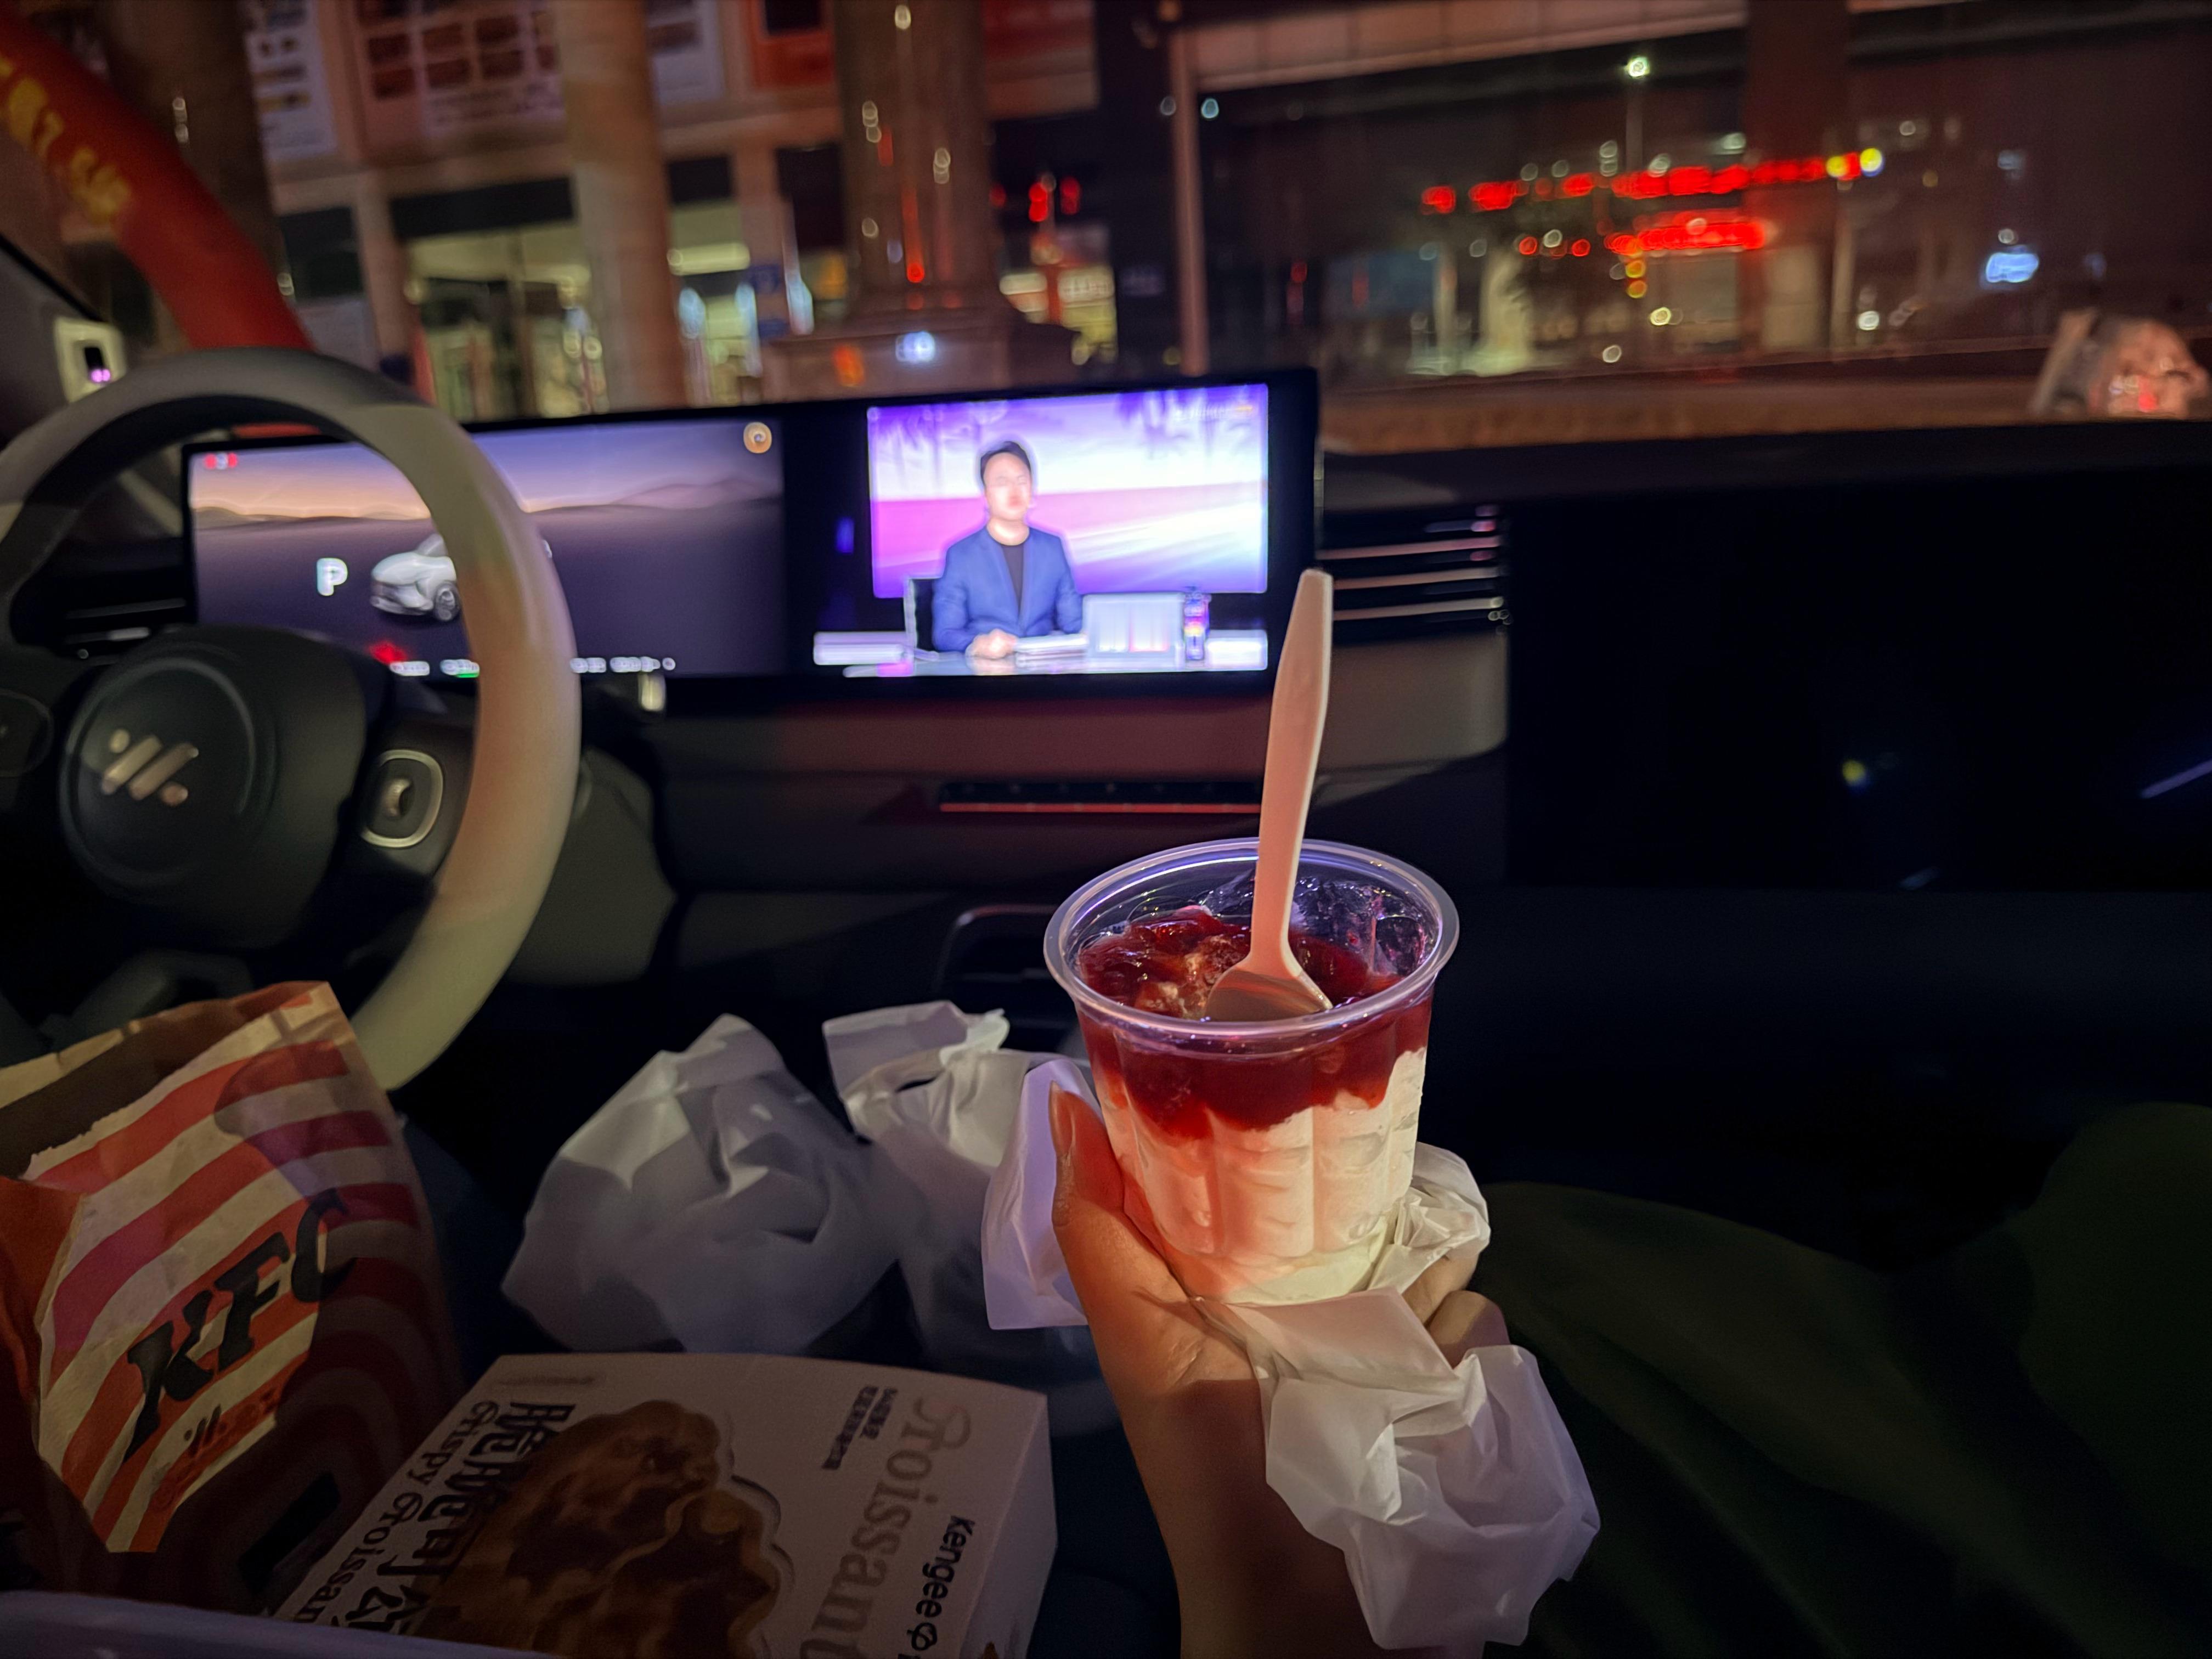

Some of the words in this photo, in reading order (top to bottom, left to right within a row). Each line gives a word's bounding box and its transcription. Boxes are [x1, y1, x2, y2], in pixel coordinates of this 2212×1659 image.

[316, 557, 348, 596] P
[122, 1186, 357, 1462] KFC
[407, 1400, 500, 1485] Crispy
[292, 1492, 424, 1622] Croissan
[916, 1515, 975, 1619] Kengee
